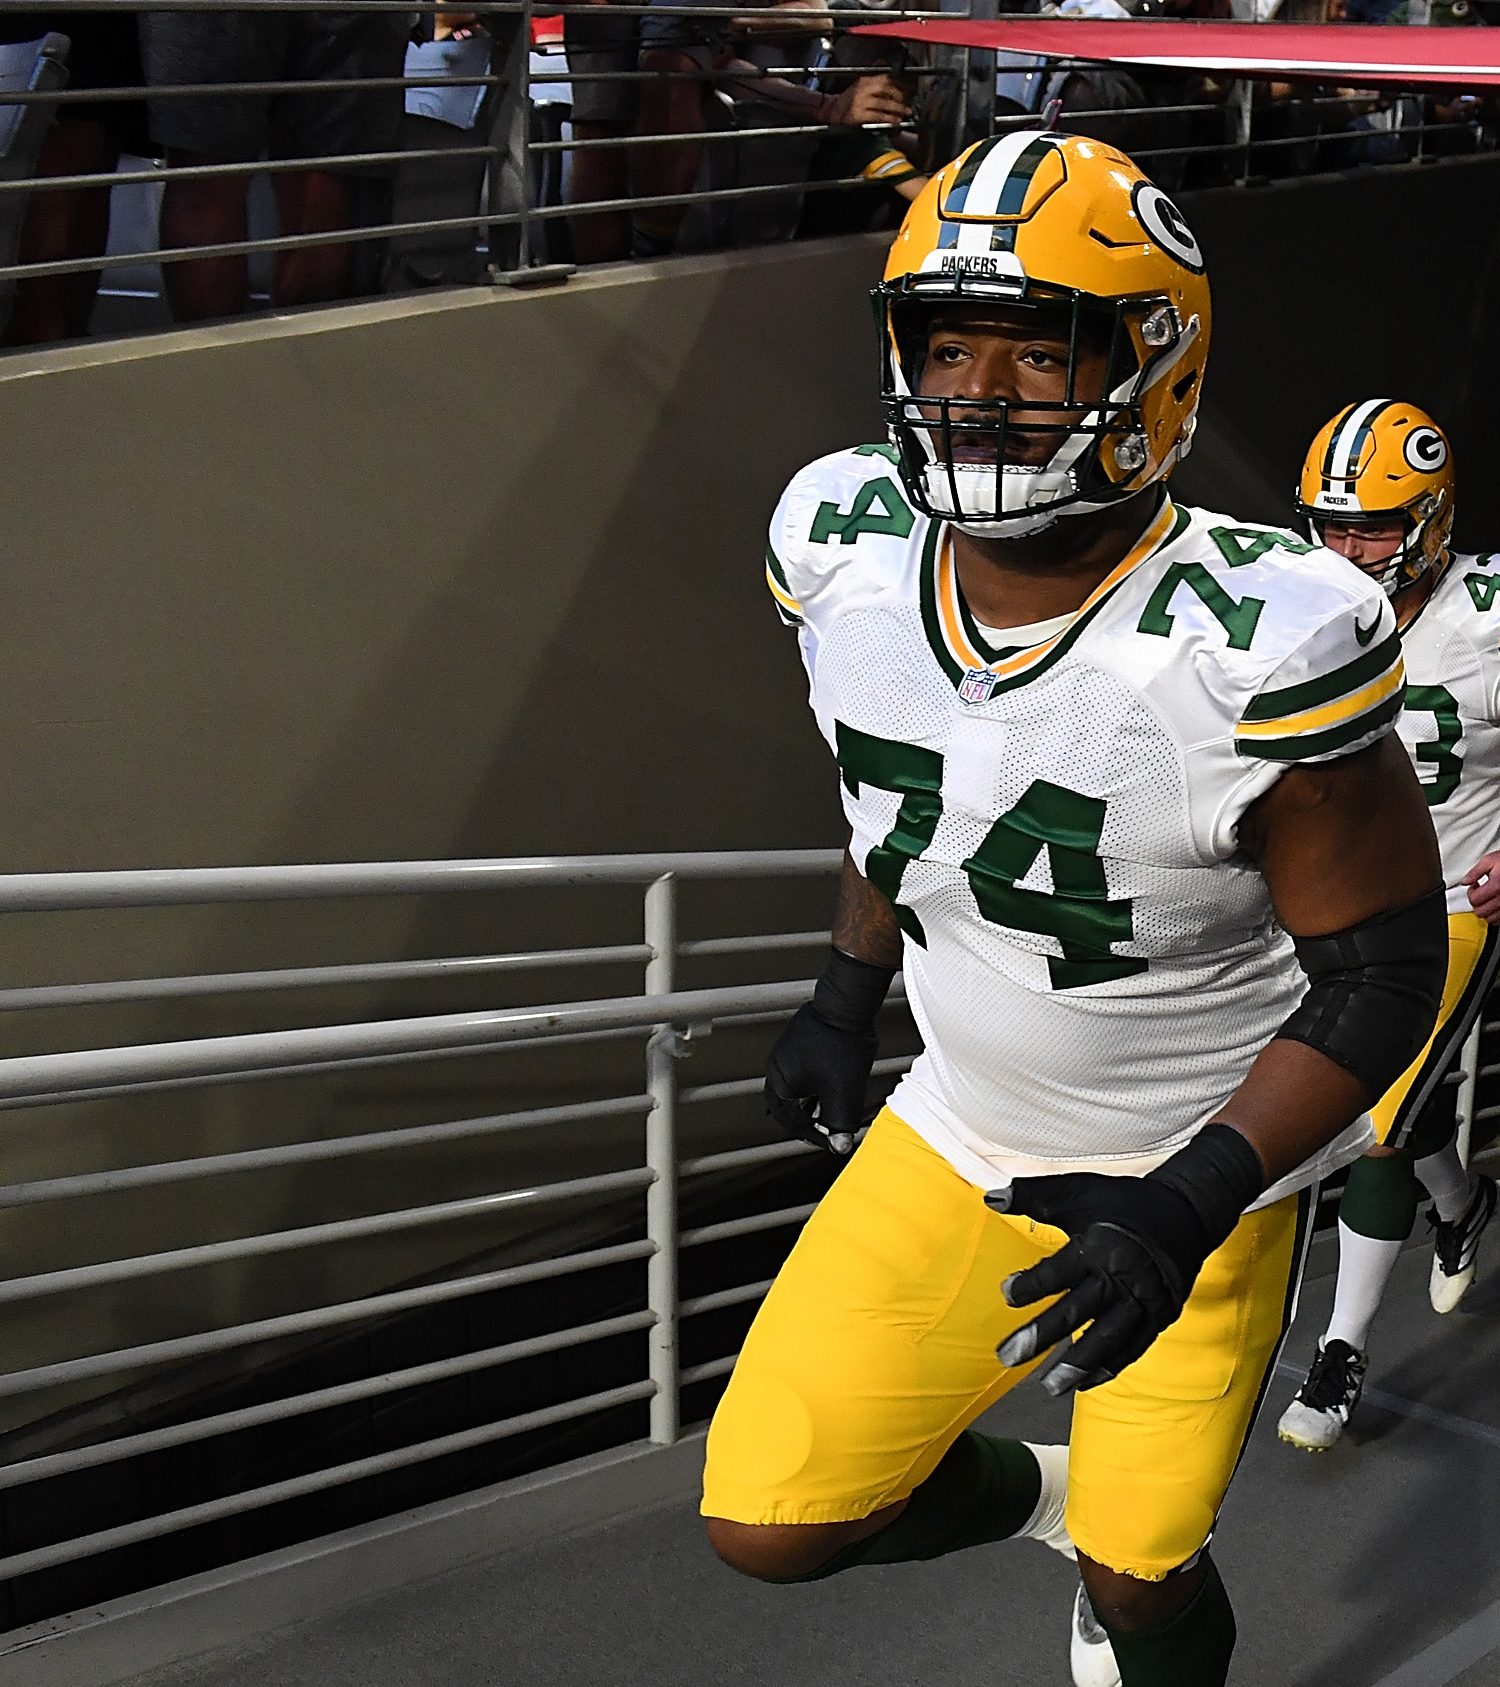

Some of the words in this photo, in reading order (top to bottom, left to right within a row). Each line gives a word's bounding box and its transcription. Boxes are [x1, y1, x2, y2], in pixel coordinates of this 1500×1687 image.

[941, 256, 998, 273] PACKERS
[1405, 428, 1446, 470] G
[1136, 526, 1325, 652] 74
[834, 718, 1150, 990] 74
